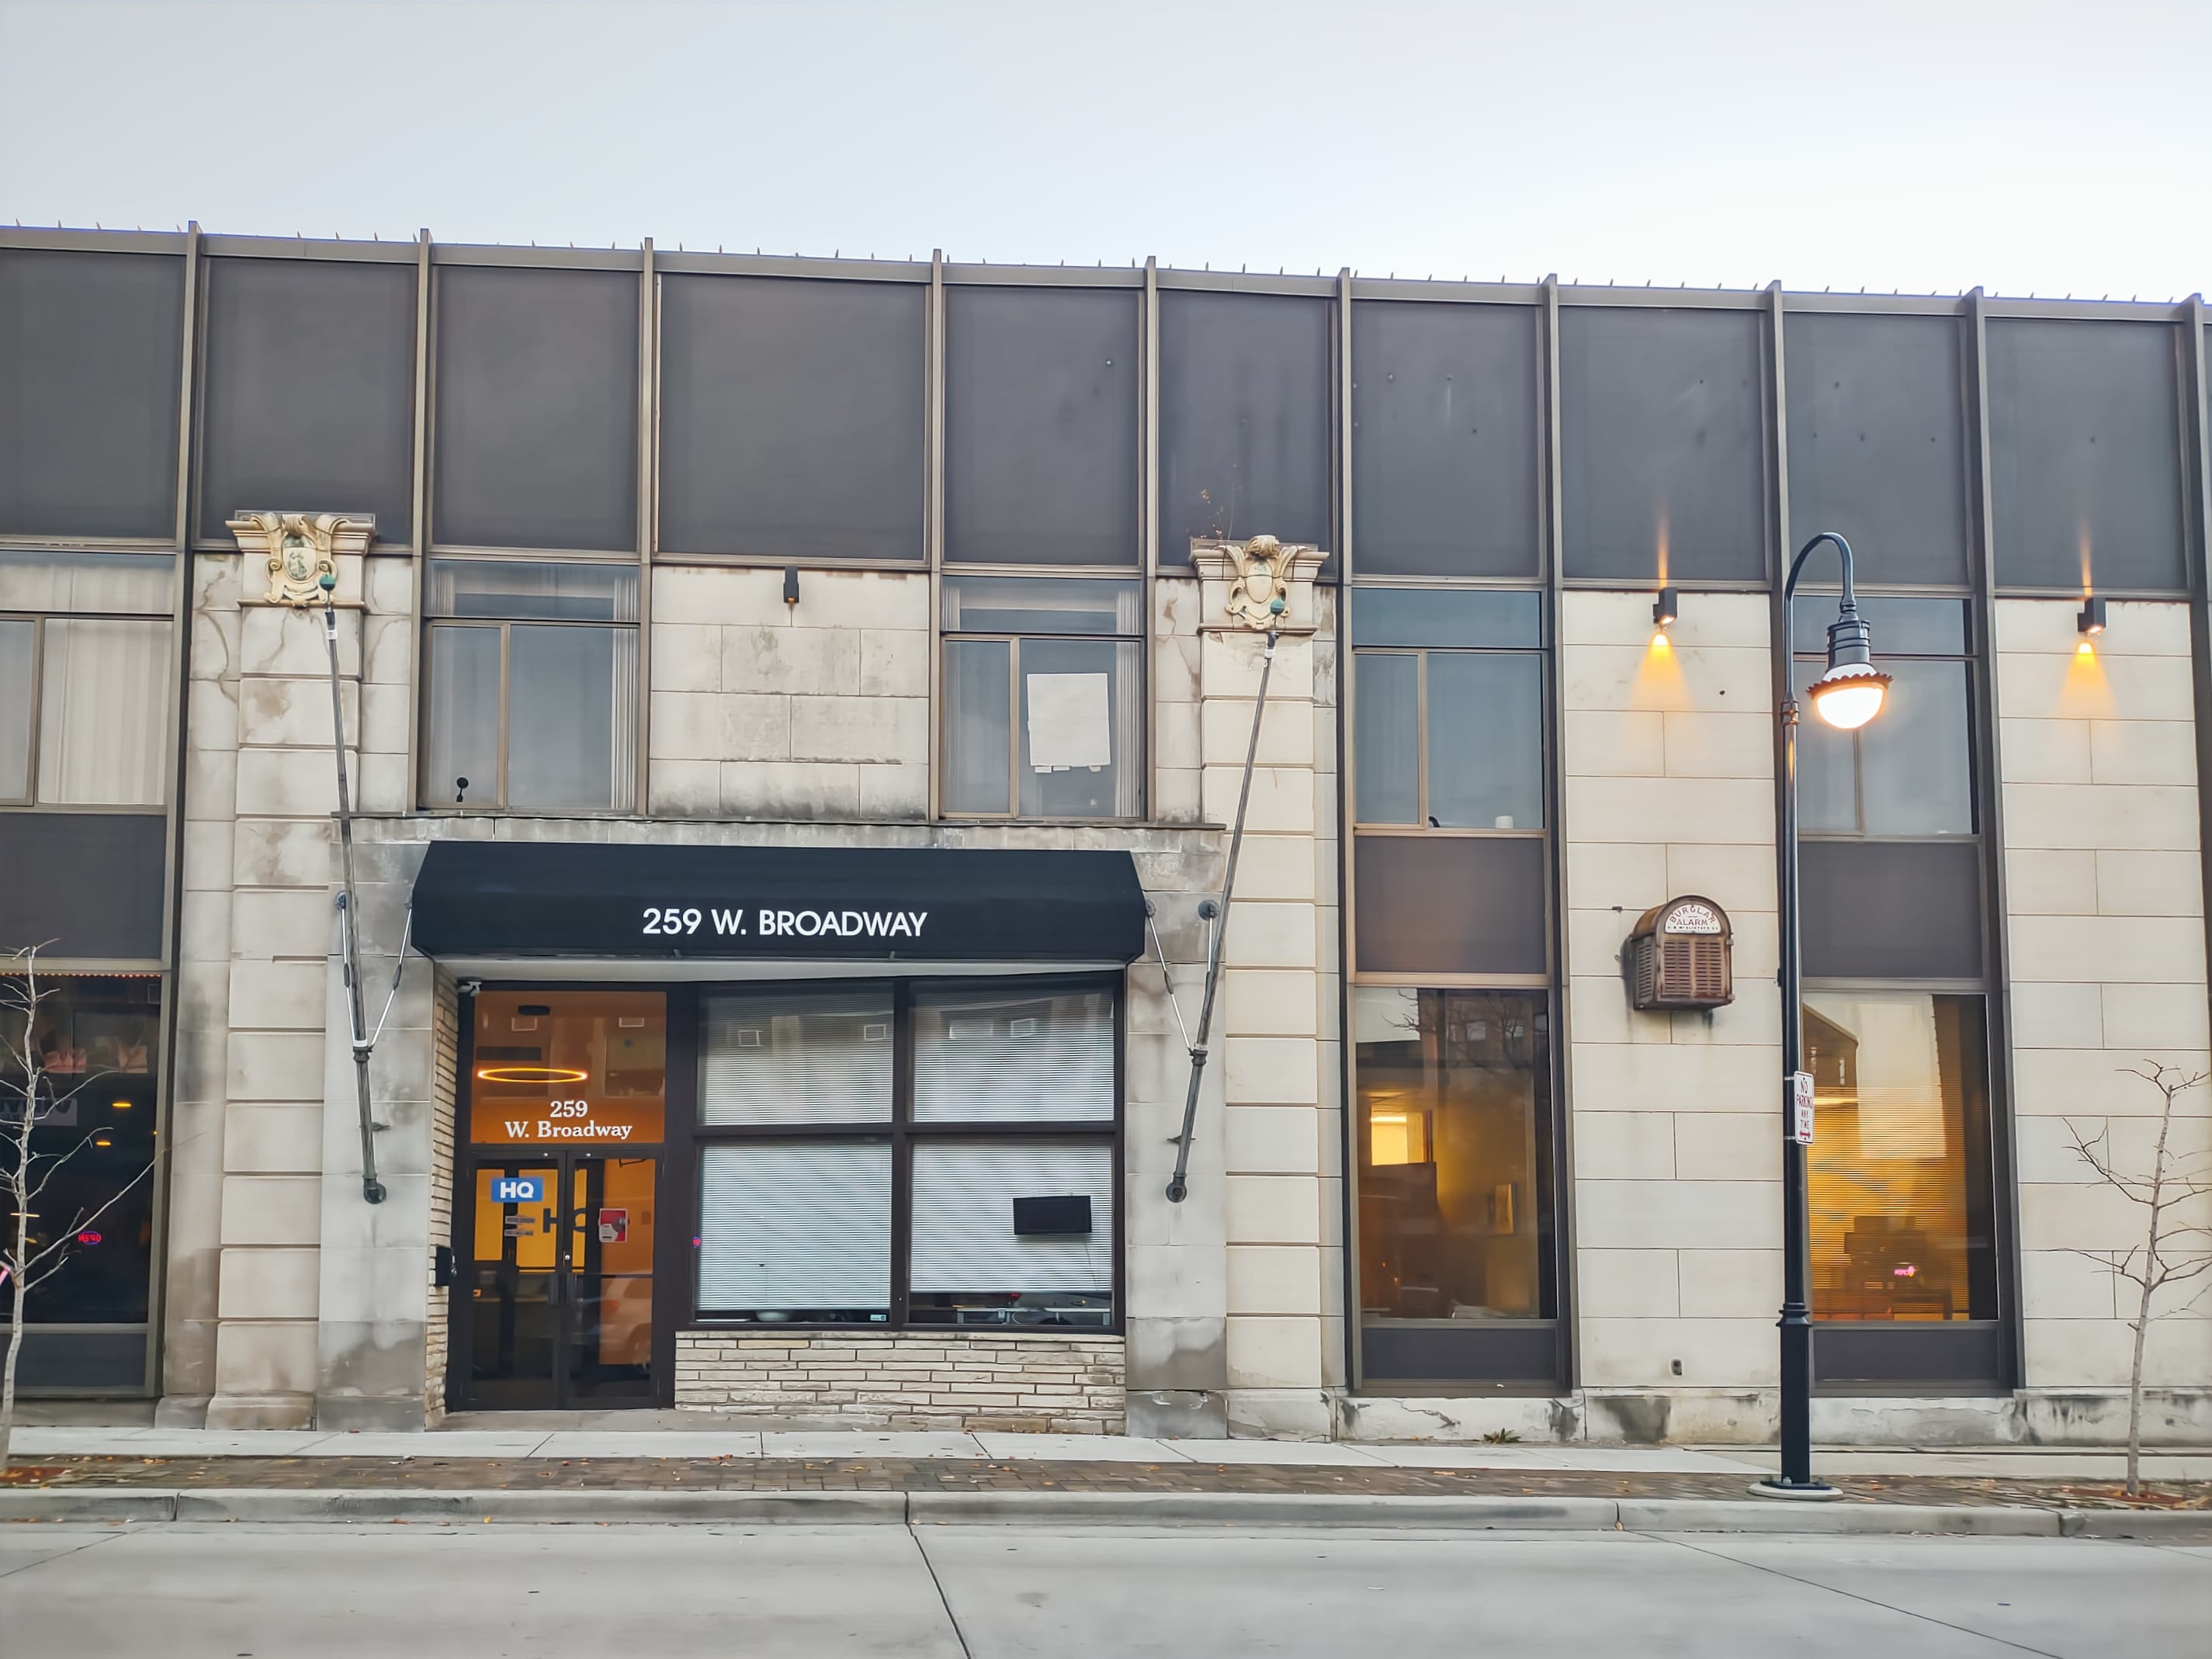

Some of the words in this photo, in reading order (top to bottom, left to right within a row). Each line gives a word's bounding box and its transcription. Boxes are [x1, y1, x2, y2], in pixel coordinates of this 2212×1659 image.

[643, 908, 702, 934] 259
[711, 909, 747, 935] W.
[759, 909, 927, 937] BROADWAY
[1669, 906, 1716, 923] BURGLAR
[1801, 1080, 1808, 1094] NO
[550, 1100, 588, 1118] 259
[504, 1121, 529, 1138] W.
[537, 1120, 633, 1140] Broadway
[500, 1182, 534, 1199] HQ
